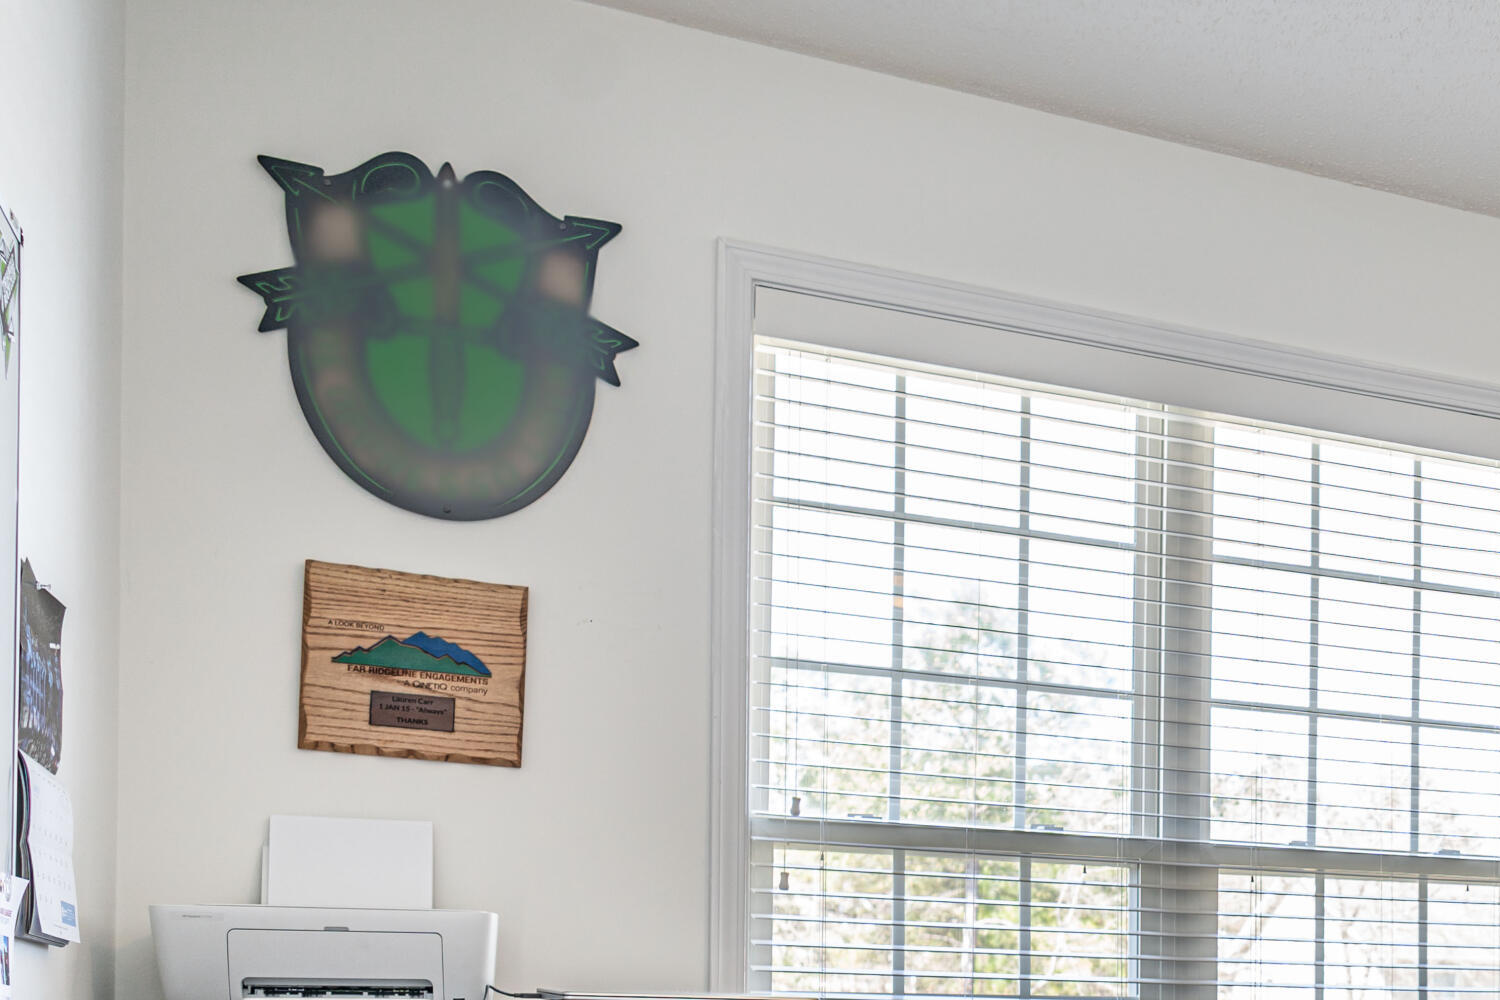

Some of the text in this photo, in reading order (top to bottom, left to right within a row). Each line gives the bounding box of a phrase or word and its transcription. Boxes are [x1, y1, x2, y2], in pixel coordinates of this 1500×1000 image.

[335, 620, 353, 628] LOOK
[354, 622, 384, 631] BEYOND
[347, 664, 488, 686] FAR RIDGELINE ENGAGEMENTS
[451, 685, 488, 695] company
[397, 716, 428, 725] THANKS
